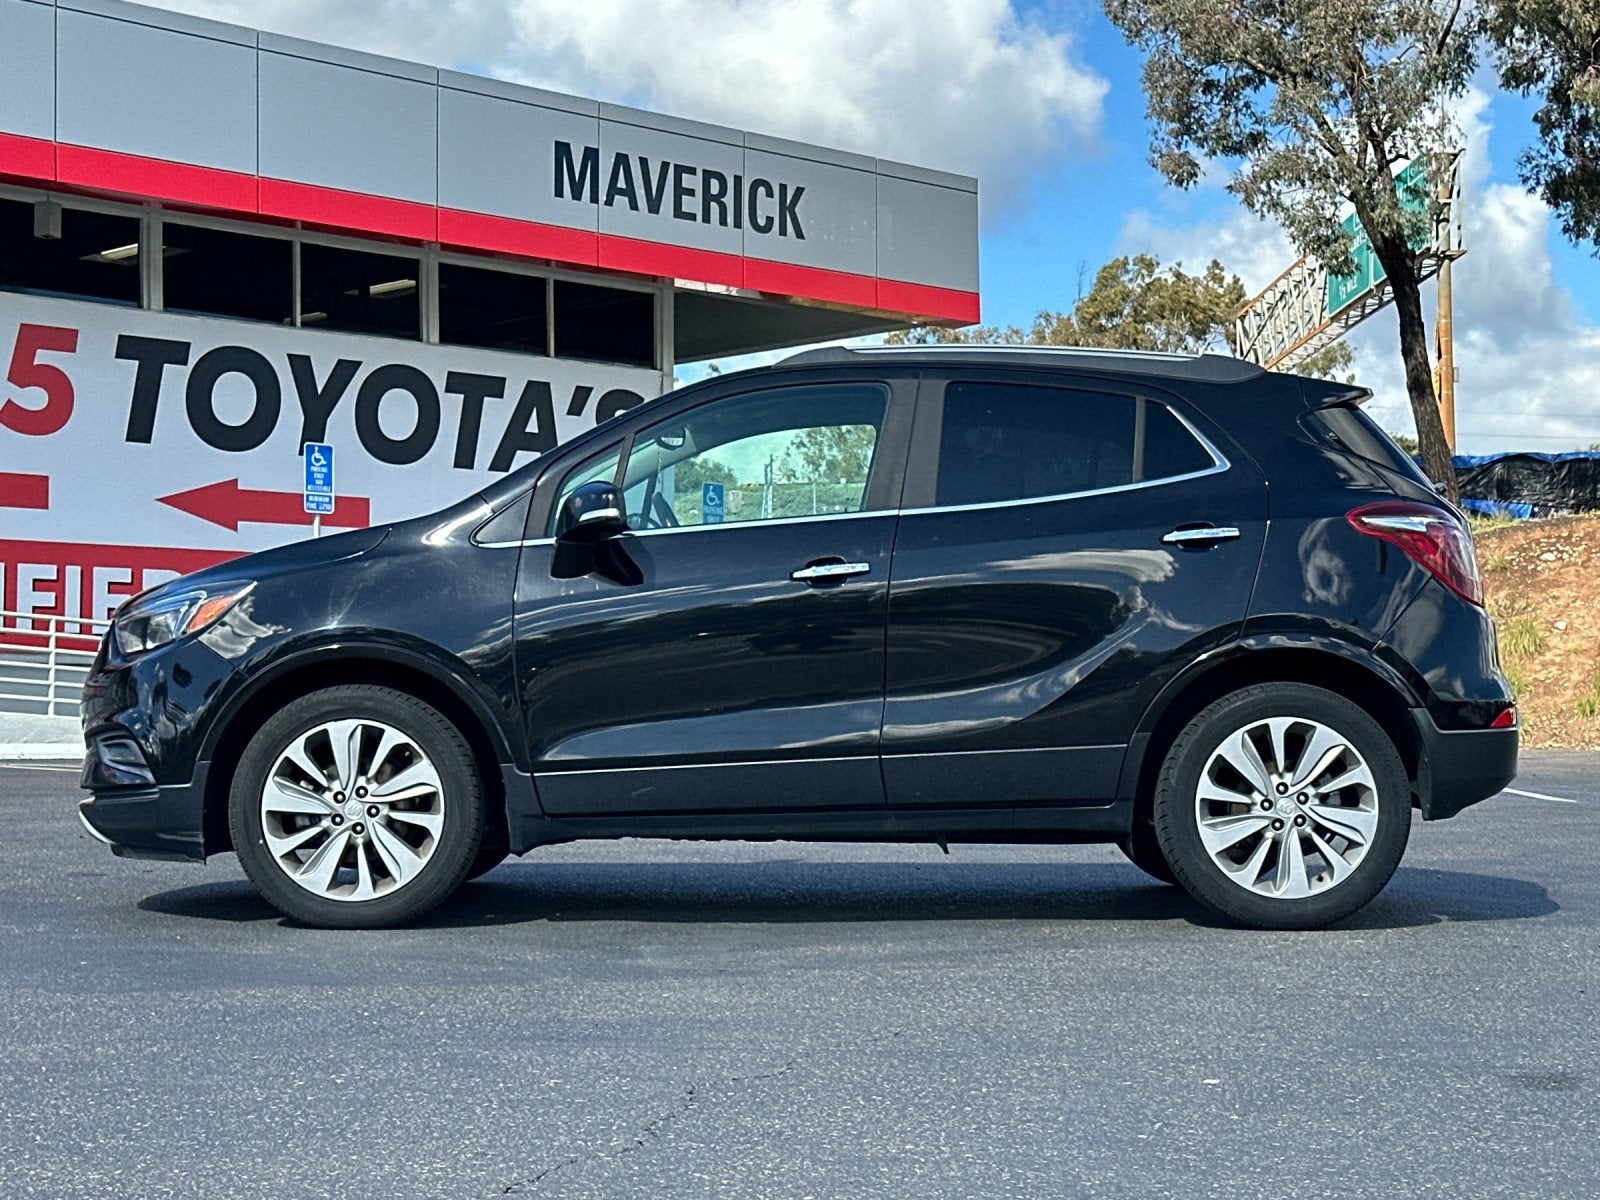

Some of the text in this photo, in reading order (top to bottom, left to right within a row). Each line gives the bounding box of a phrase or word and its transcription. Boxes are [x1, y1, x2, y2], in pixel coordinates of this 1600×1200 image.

[554, 140, 806, 240] MAVERICK
[0, 323, 79, 436] 5
[0, 562, 182, 634] FIE
